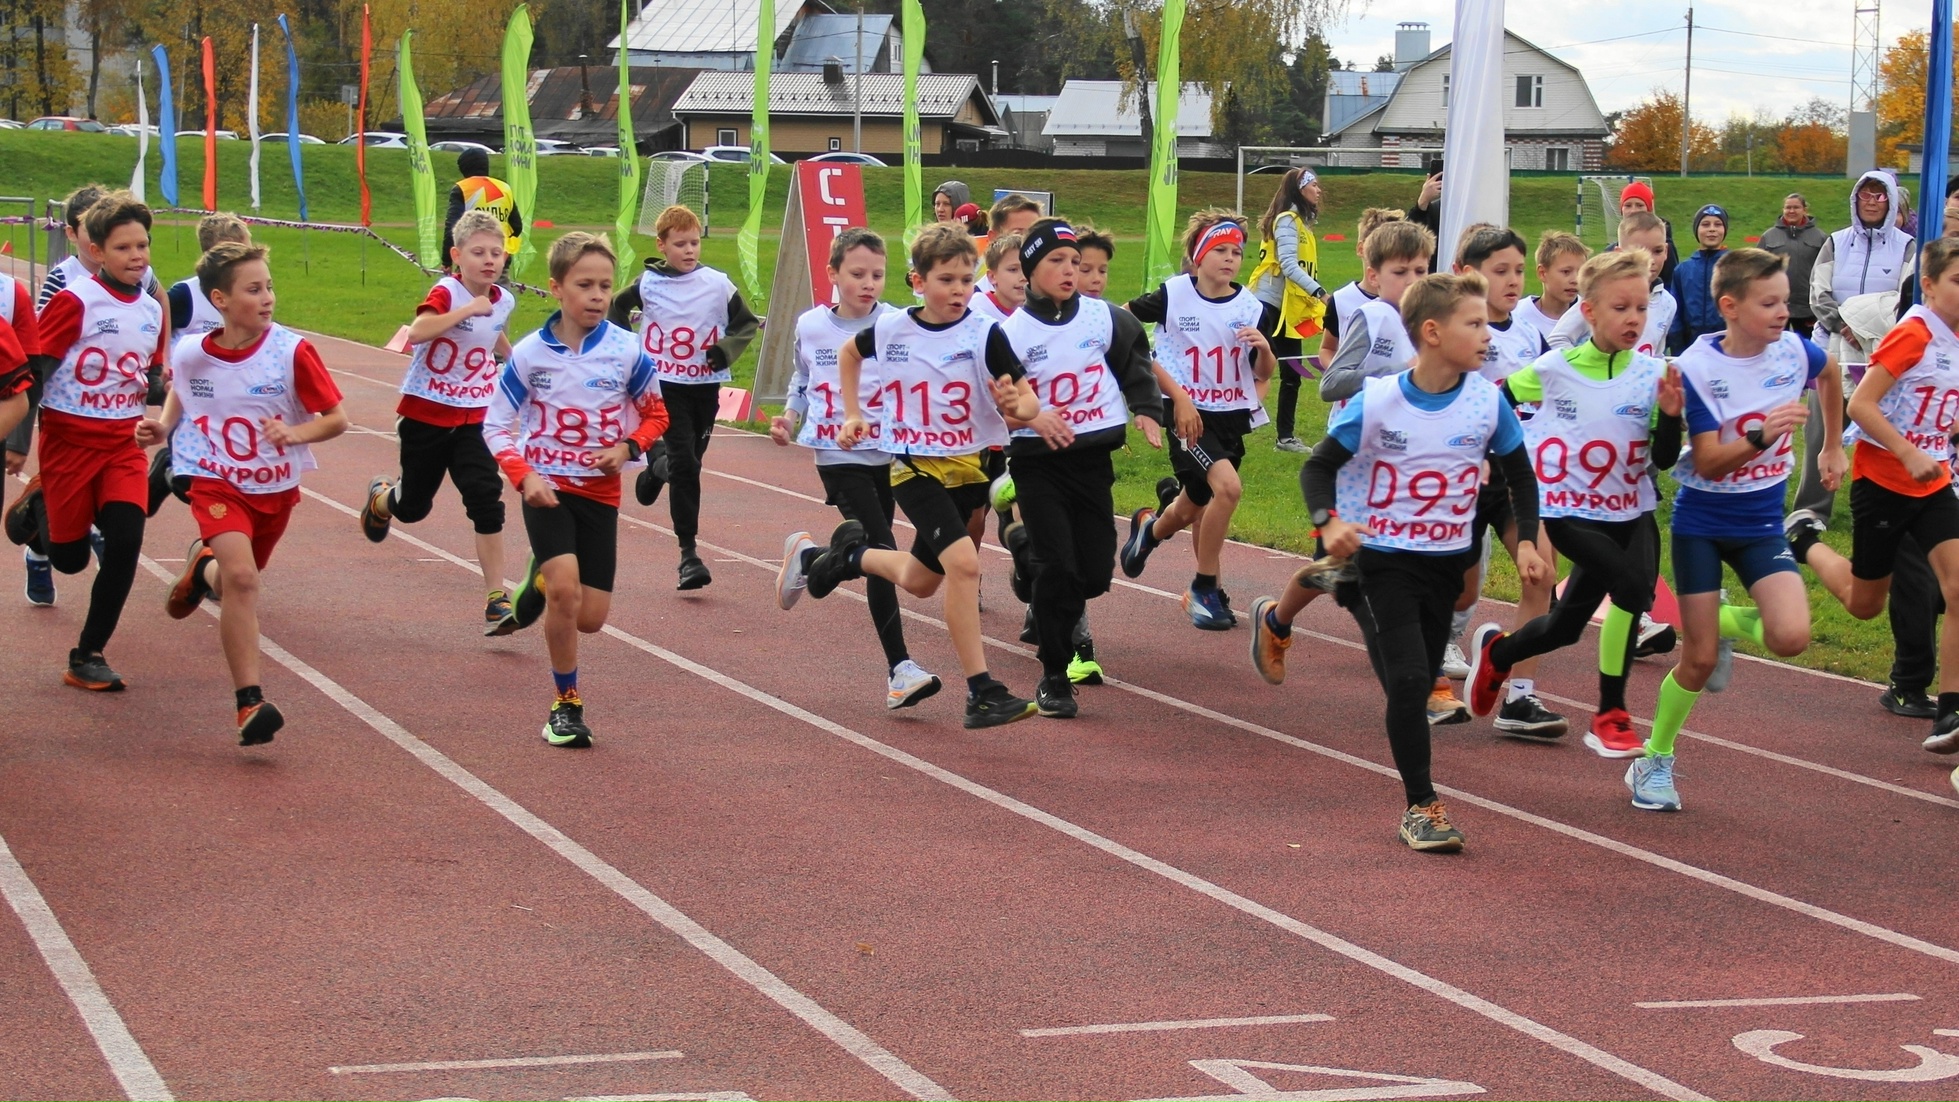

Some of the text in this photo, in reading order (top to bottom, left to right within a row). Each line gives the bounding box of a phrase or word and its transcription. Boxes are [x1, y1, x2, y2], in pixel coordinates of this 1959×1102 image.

[1185, 346, 1241, 384] 111
[428, 377, 494, 399] МУРОМ
[885, 380, 972, 427] 113
[892, 427, 973, 447] МУРОМ
[198, 457, 291, 484] МУРОМ
[1536, 437, 1649, 488] 095
[1367, 460, 1479, 517] 093
[1546, 490, 1638, 511] МУРОМ
[1368, 514, 1467, 541] МУРОМ
